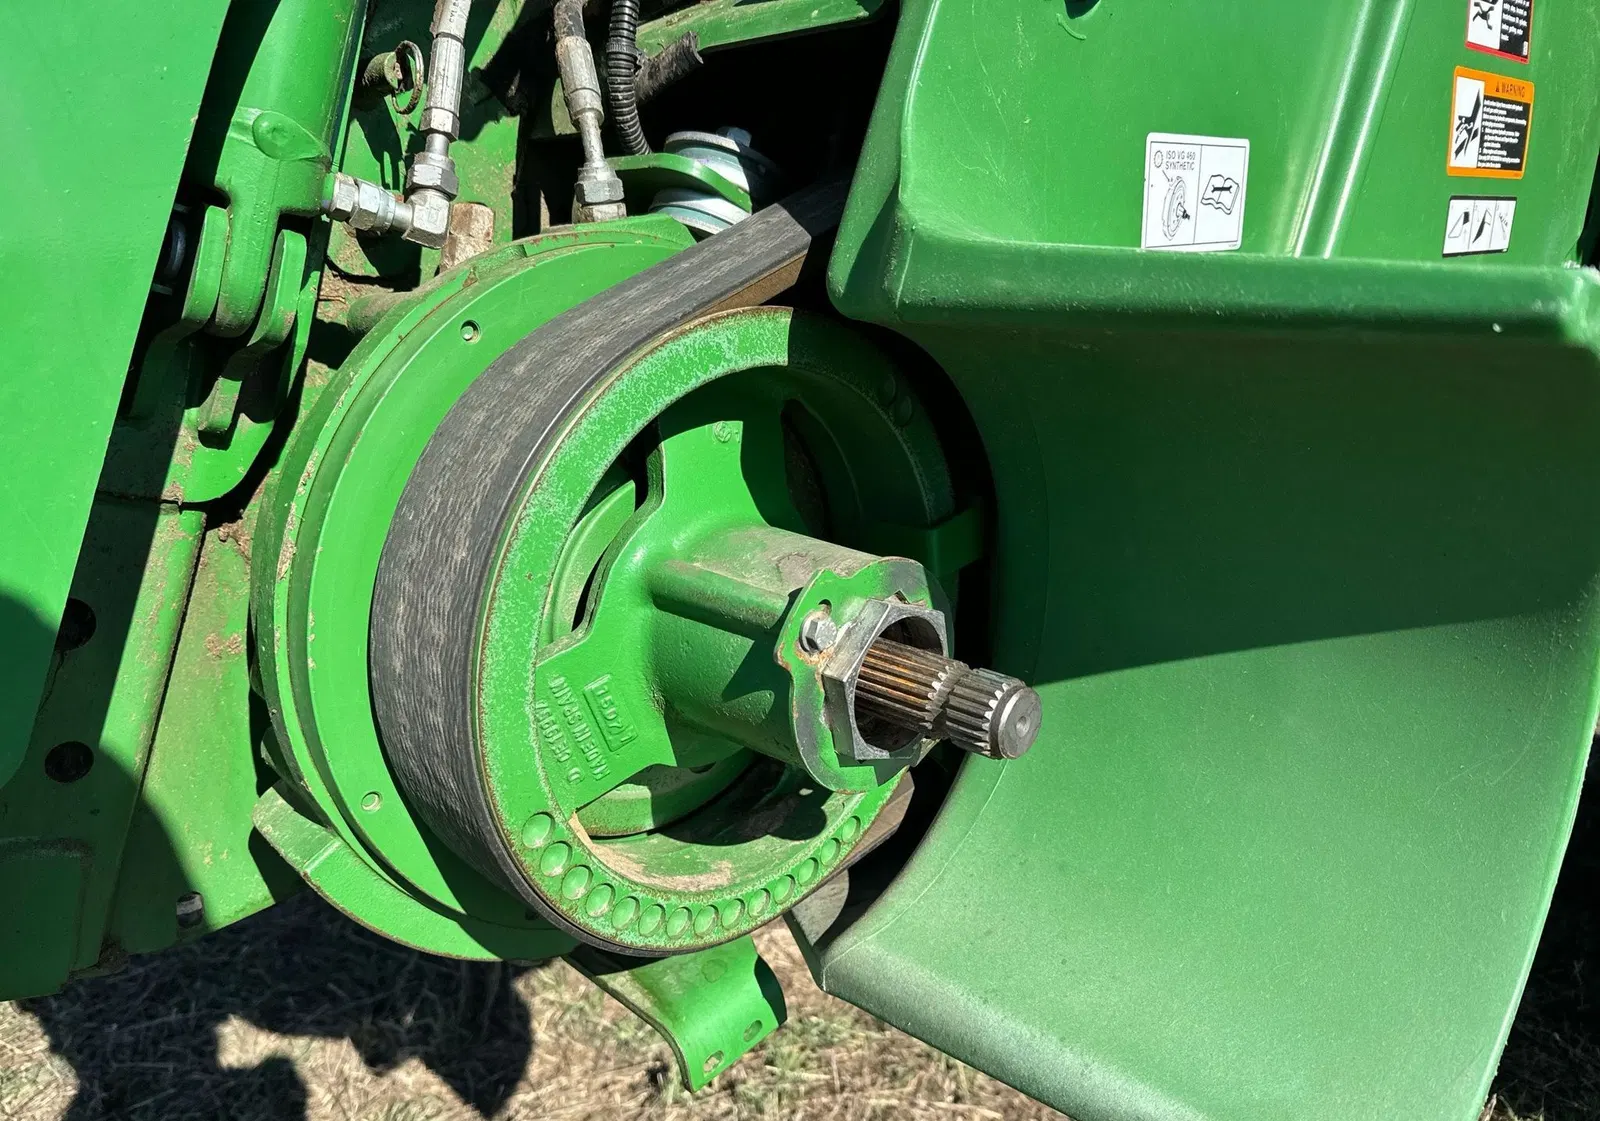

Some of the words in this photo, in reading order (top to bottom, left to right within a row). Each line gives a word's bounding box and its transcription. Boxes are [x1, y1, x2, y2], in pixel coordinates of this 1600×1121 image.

[1501, 83, 1526, 98] WARNING
[1166, 150, 1175, 160] ISO
[1177, 151, 1185, 160] VG
[1186, 151, 1196, 161] 460
[1165, 161, 1195, 170] SYNTHETIC
[548, 675, 583, 725] SPAIN
[572, 723, 592, 743] IN
[581, 740, 611, 780] MADE
